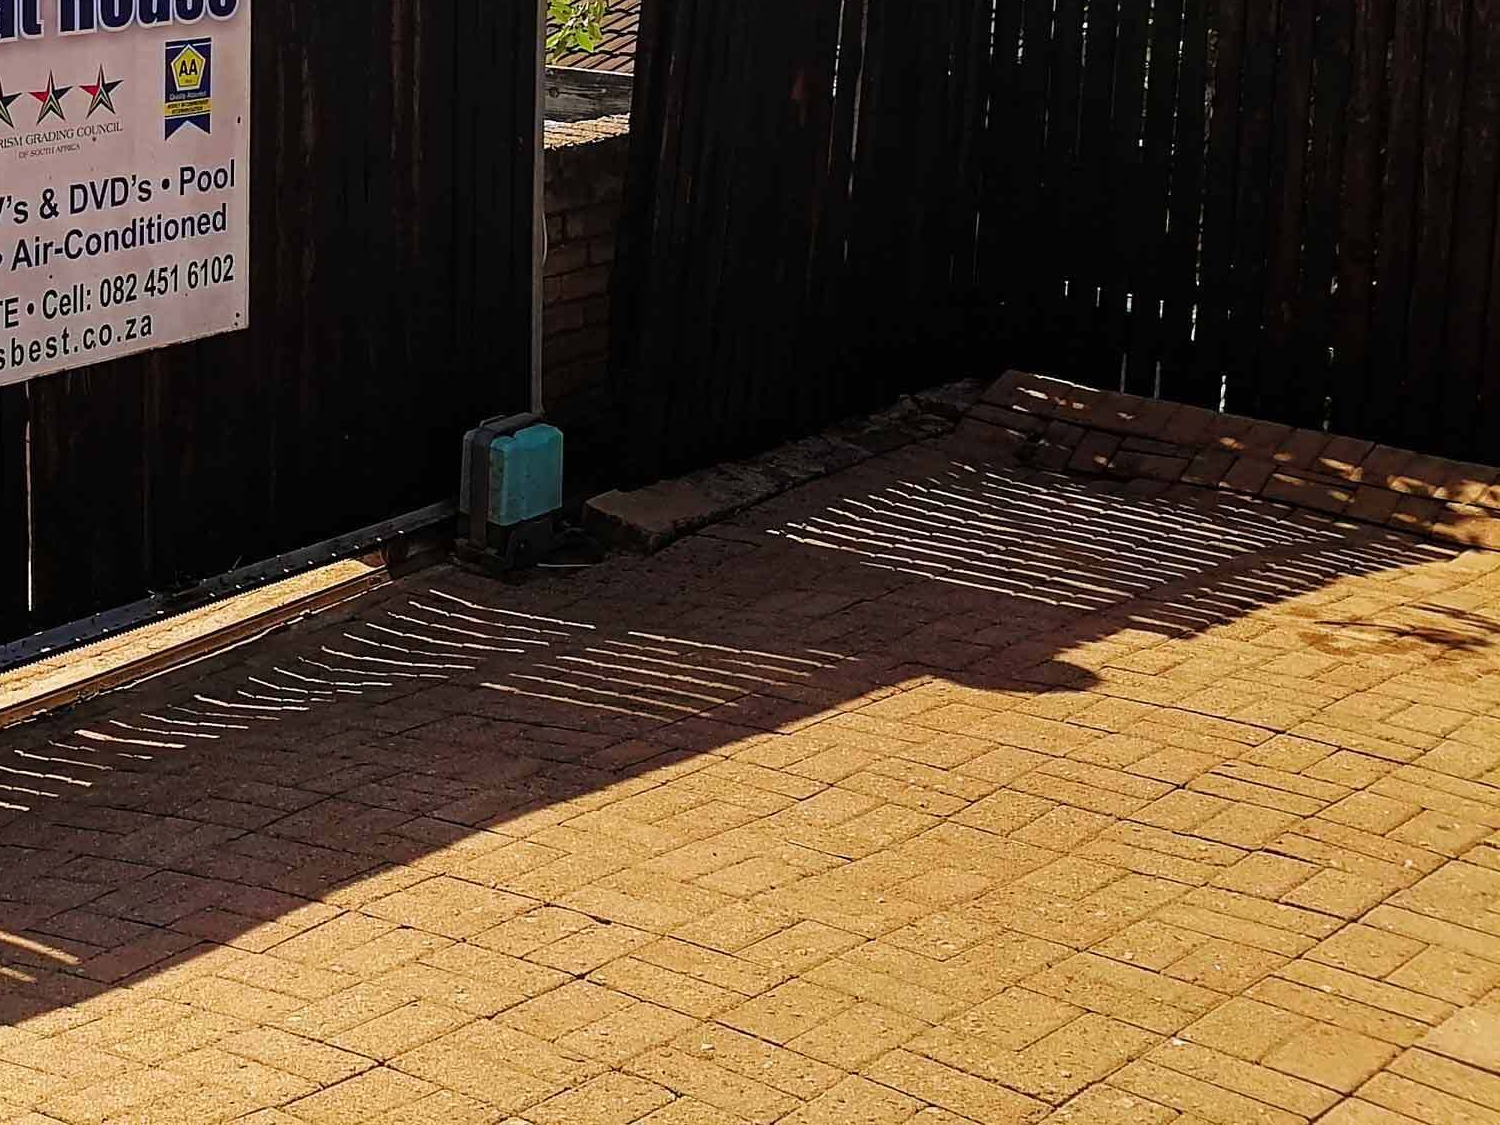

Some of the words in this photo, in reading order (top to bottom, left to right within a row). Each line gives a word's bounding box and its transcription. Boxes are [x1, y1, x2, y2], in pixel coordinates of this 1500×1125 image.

[179, 58, 199, 77] AA
[18, 150, 29, 159] OF
[30, 146, 55, 157] SOUTH
[55, 143, 81, 154] AFRICA
[25, 128, 75, 146] GRADING
[76, 122, 124, 138] COUNCIL
[39, 188, 60, 220] &
[69, 174, 152, 215] DVD's
[179, 159, 235, 196] Pool
[11, 202, 227, 272] Air-Conditioned
[42, 283, 92, 319] Cell:
[100, 273, 138, 308] 082
[144, 264, 179, 297] 451
[187, 254, 234, 289] 6102
